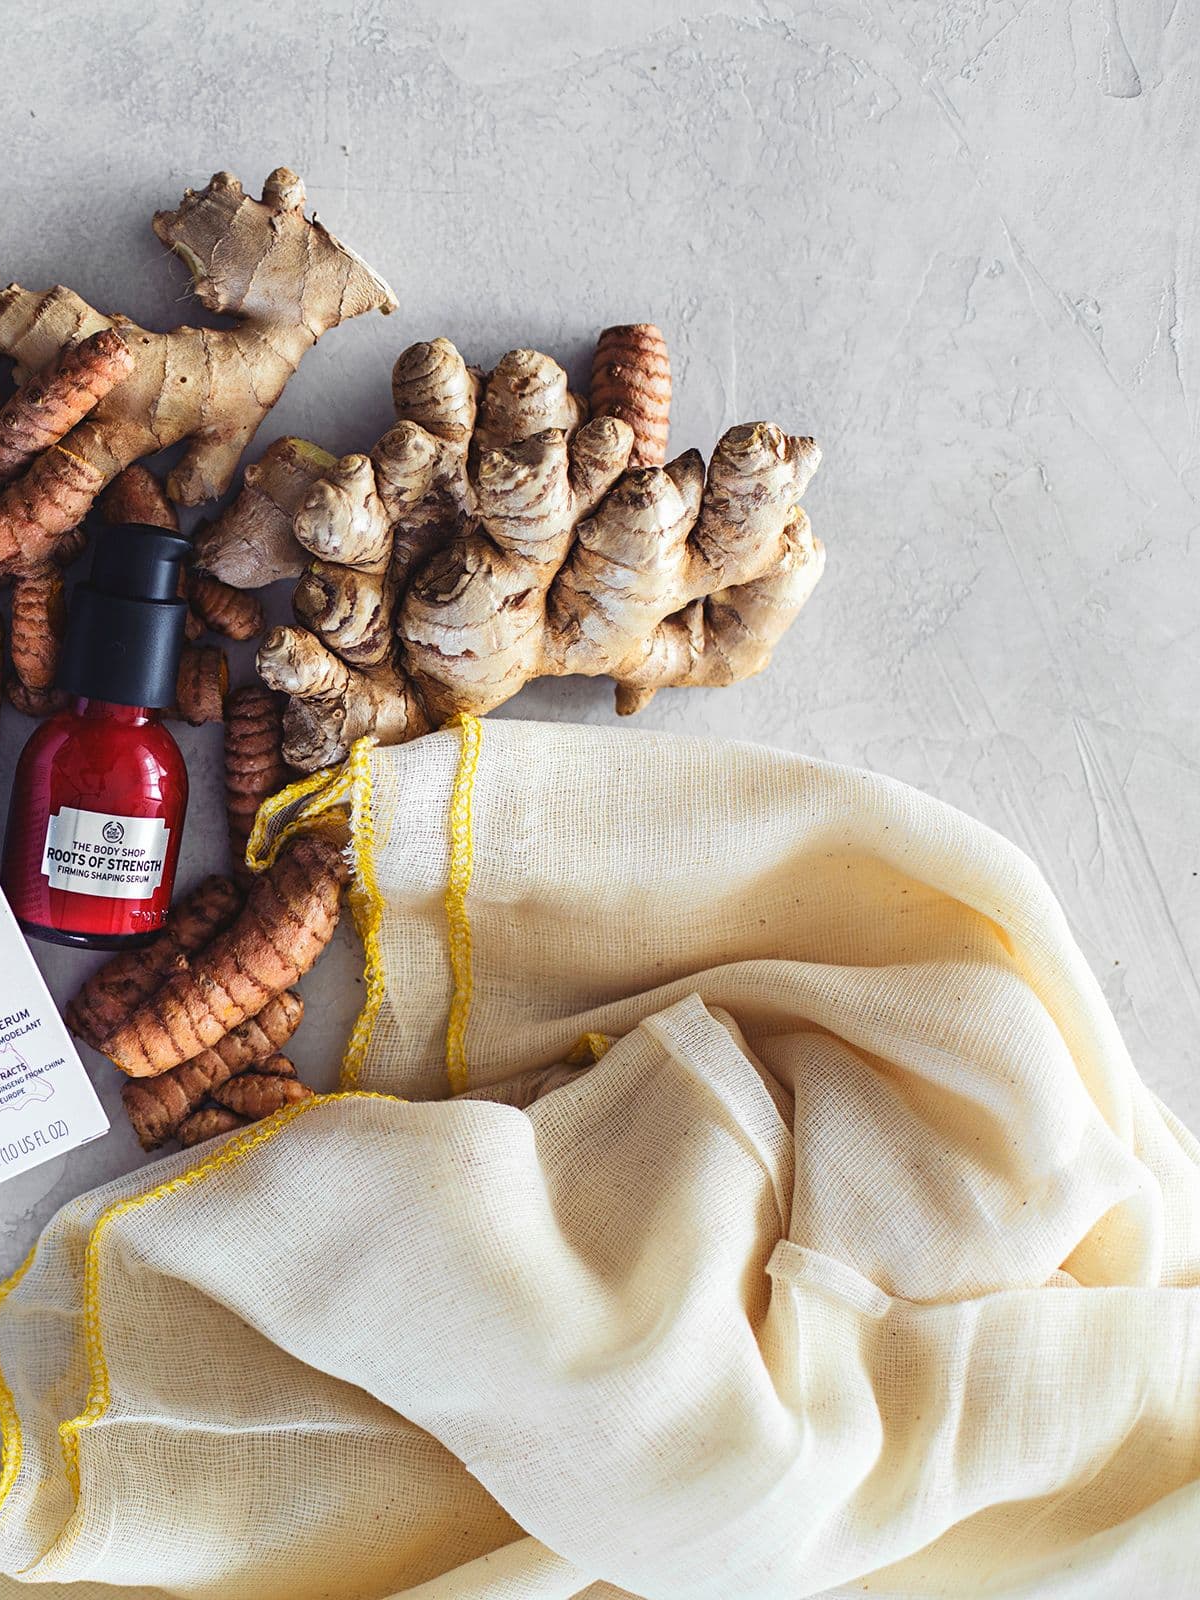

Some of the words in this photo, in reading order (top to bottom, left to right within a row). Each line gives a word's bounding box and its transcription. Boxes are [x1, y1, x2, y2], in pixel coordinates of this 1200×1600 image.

[73, 841, 91, 852] THE
[94, 845, 120, 856] BODY
[122, 848, 145, 857] SHOP
[47, 847, 85, 866] ROOTS
[89, 856, 105, 869] OF
[107, 859, 161, 872] STRENGTH
[57, 865, 89, 878] FIRMING
[91, 872, 125, 882] SHAPING
[126, 875, 149, 883] SERUM
[25, 1068, 44, 1081] FROM
[44, 1058, 66, 1072] CHINA
[0, 1087, 26, 1105] EUROPE
[0, 1143, 19, 1165] (1.0
[17, 1135, 36, 1155] US
[33, 1129, 50, 1147] FL
[48, 1119, 70, 1140] OZ)
